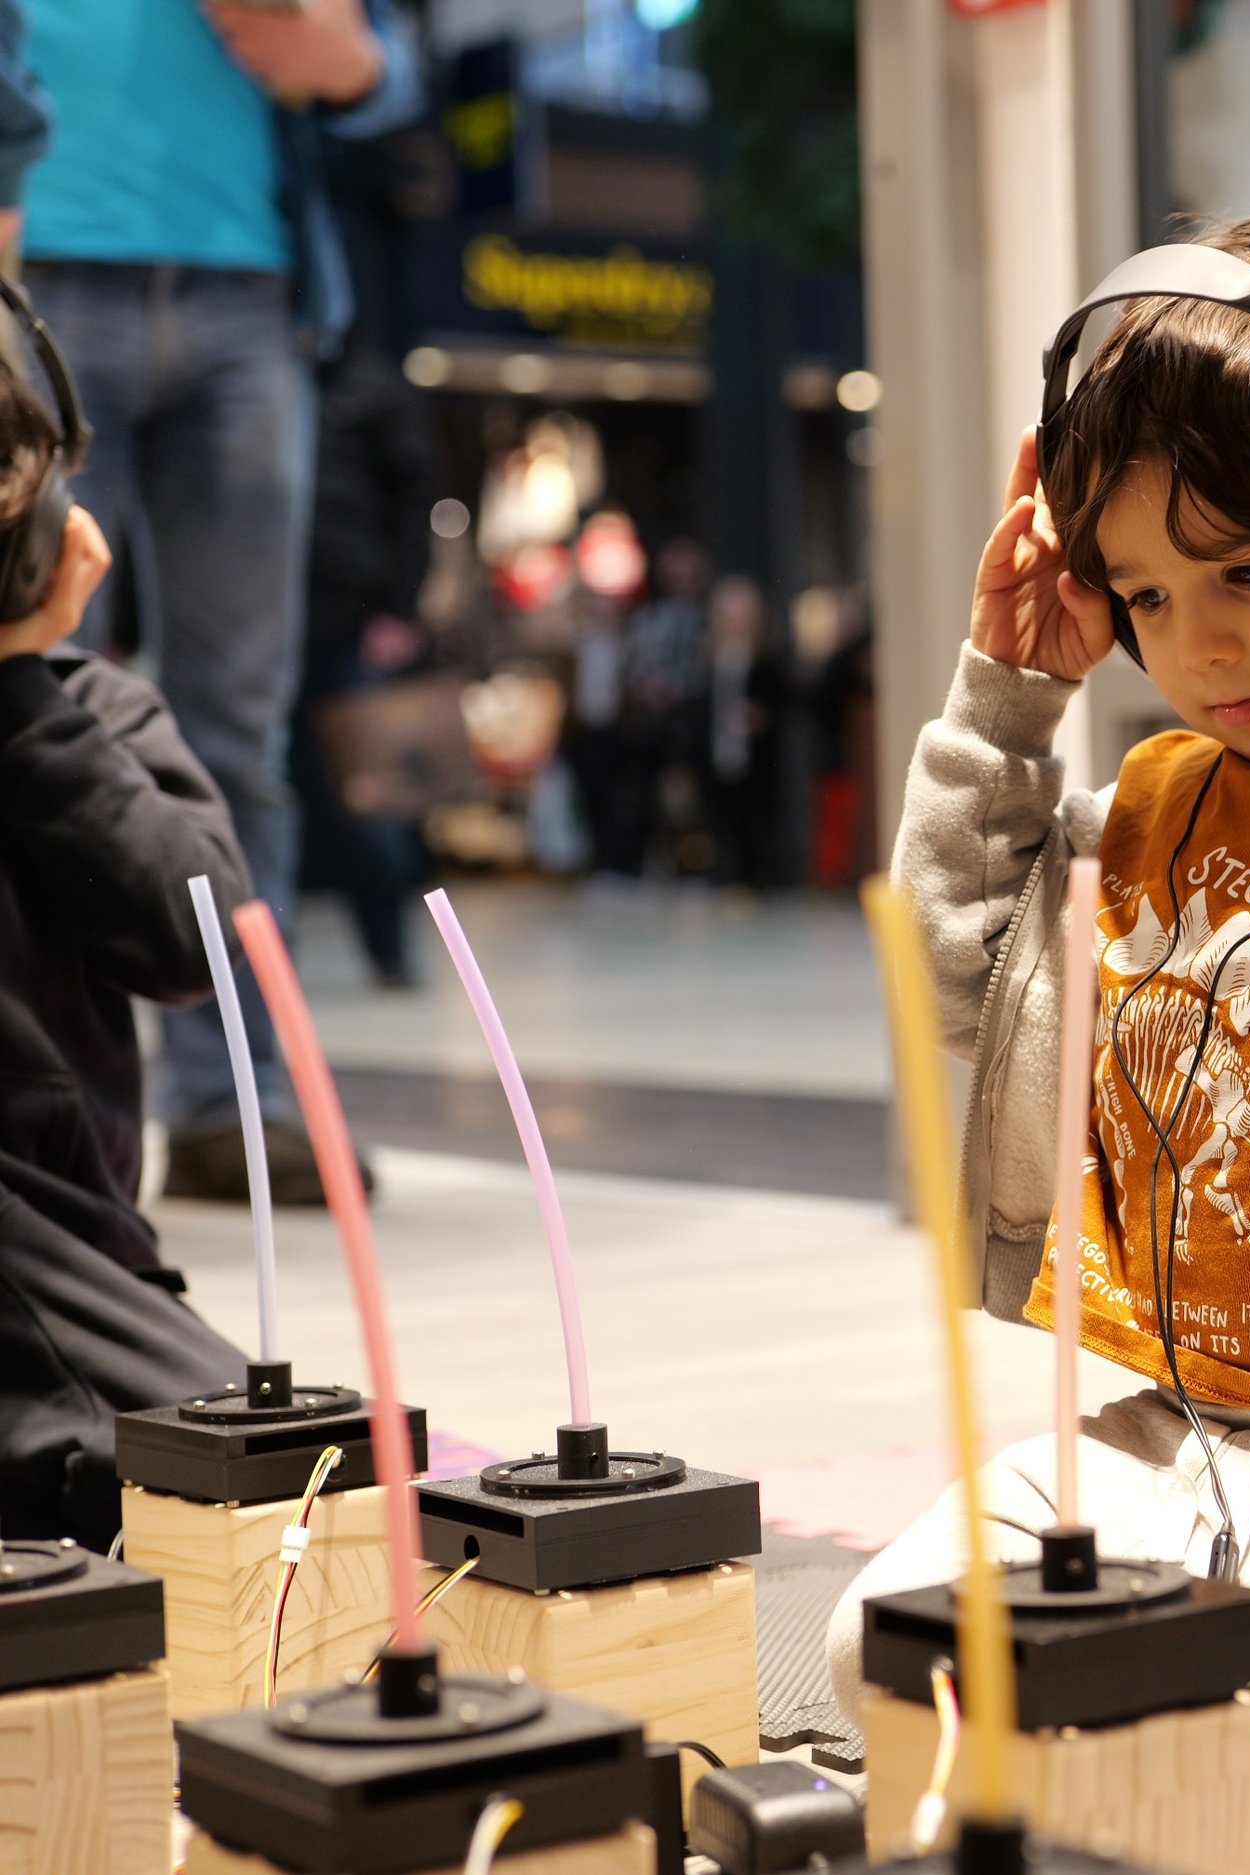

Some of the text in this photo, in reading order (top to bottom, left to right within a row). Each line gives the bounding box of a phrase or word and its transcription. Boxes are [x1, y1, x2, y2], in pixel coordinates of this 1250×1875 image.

[1105, 1069, 1137, 1160] THIGH BONE
[1180, 1331, 1201, 1350] ON
[1210, 1334, 1241, 1356] ITS
